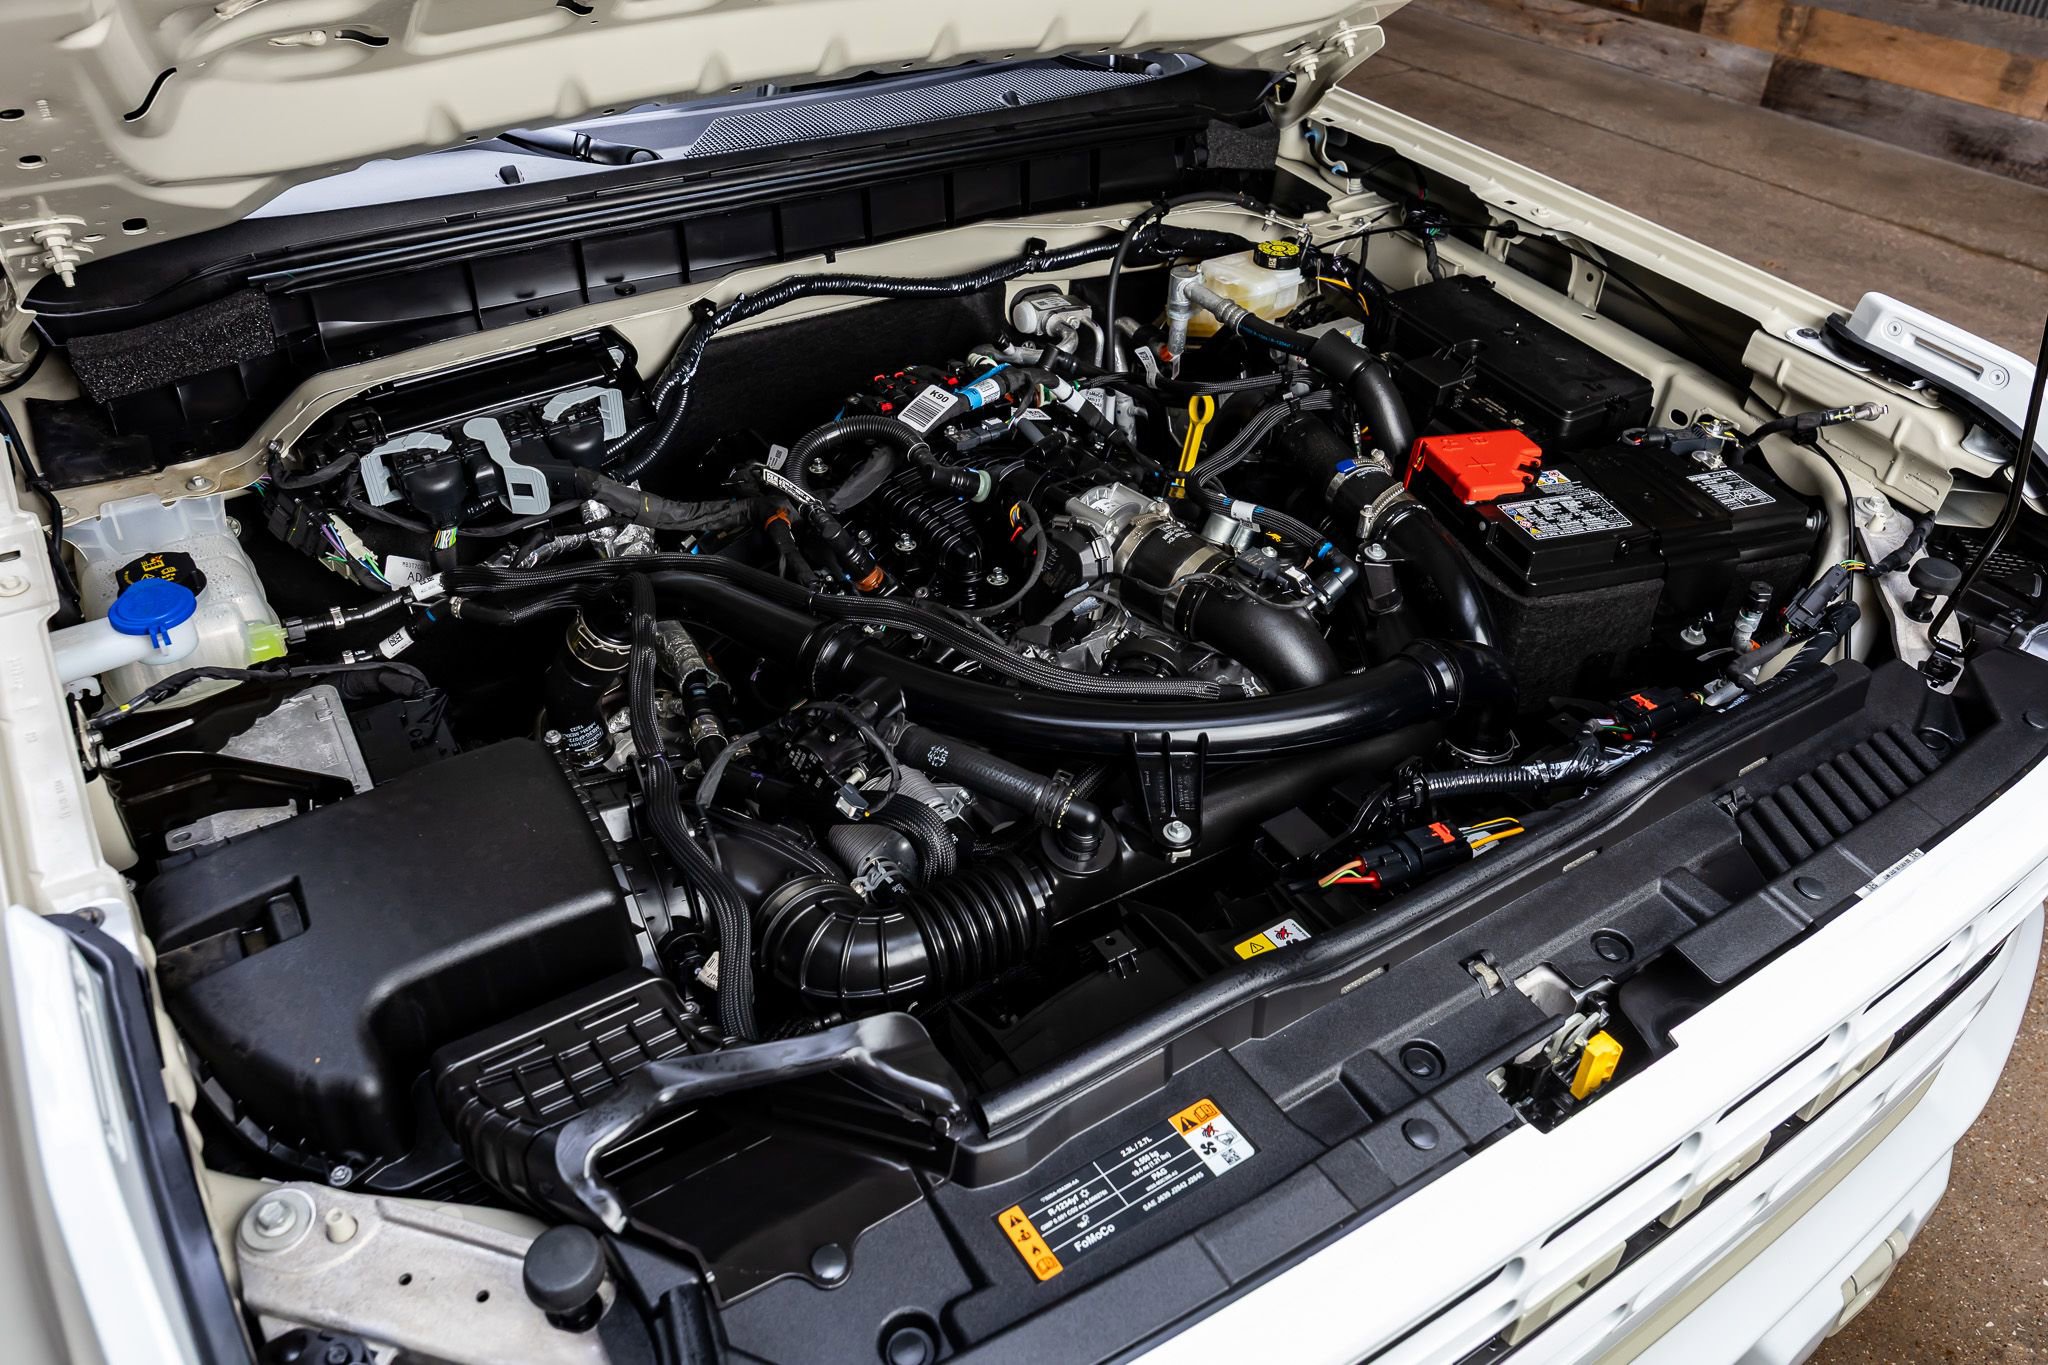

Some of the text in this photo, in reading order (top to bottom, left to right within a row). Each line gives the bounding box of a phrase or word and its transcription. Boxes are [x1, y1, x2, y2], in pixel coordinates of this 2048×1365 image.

[929, 390, 950, 403] K90
[1120, 1145, 1136, 1158] 2.3L
[1137, 1136, 1153, 1148] 2.7L
[1150, 1168, 1168, 1181] PAG
[1047, 1194, 1079, 1217] R-1234yf
[1142, 1199, 1158, 1212] SAE
[1073, 1224, 1116, 1253] FoMoCo
